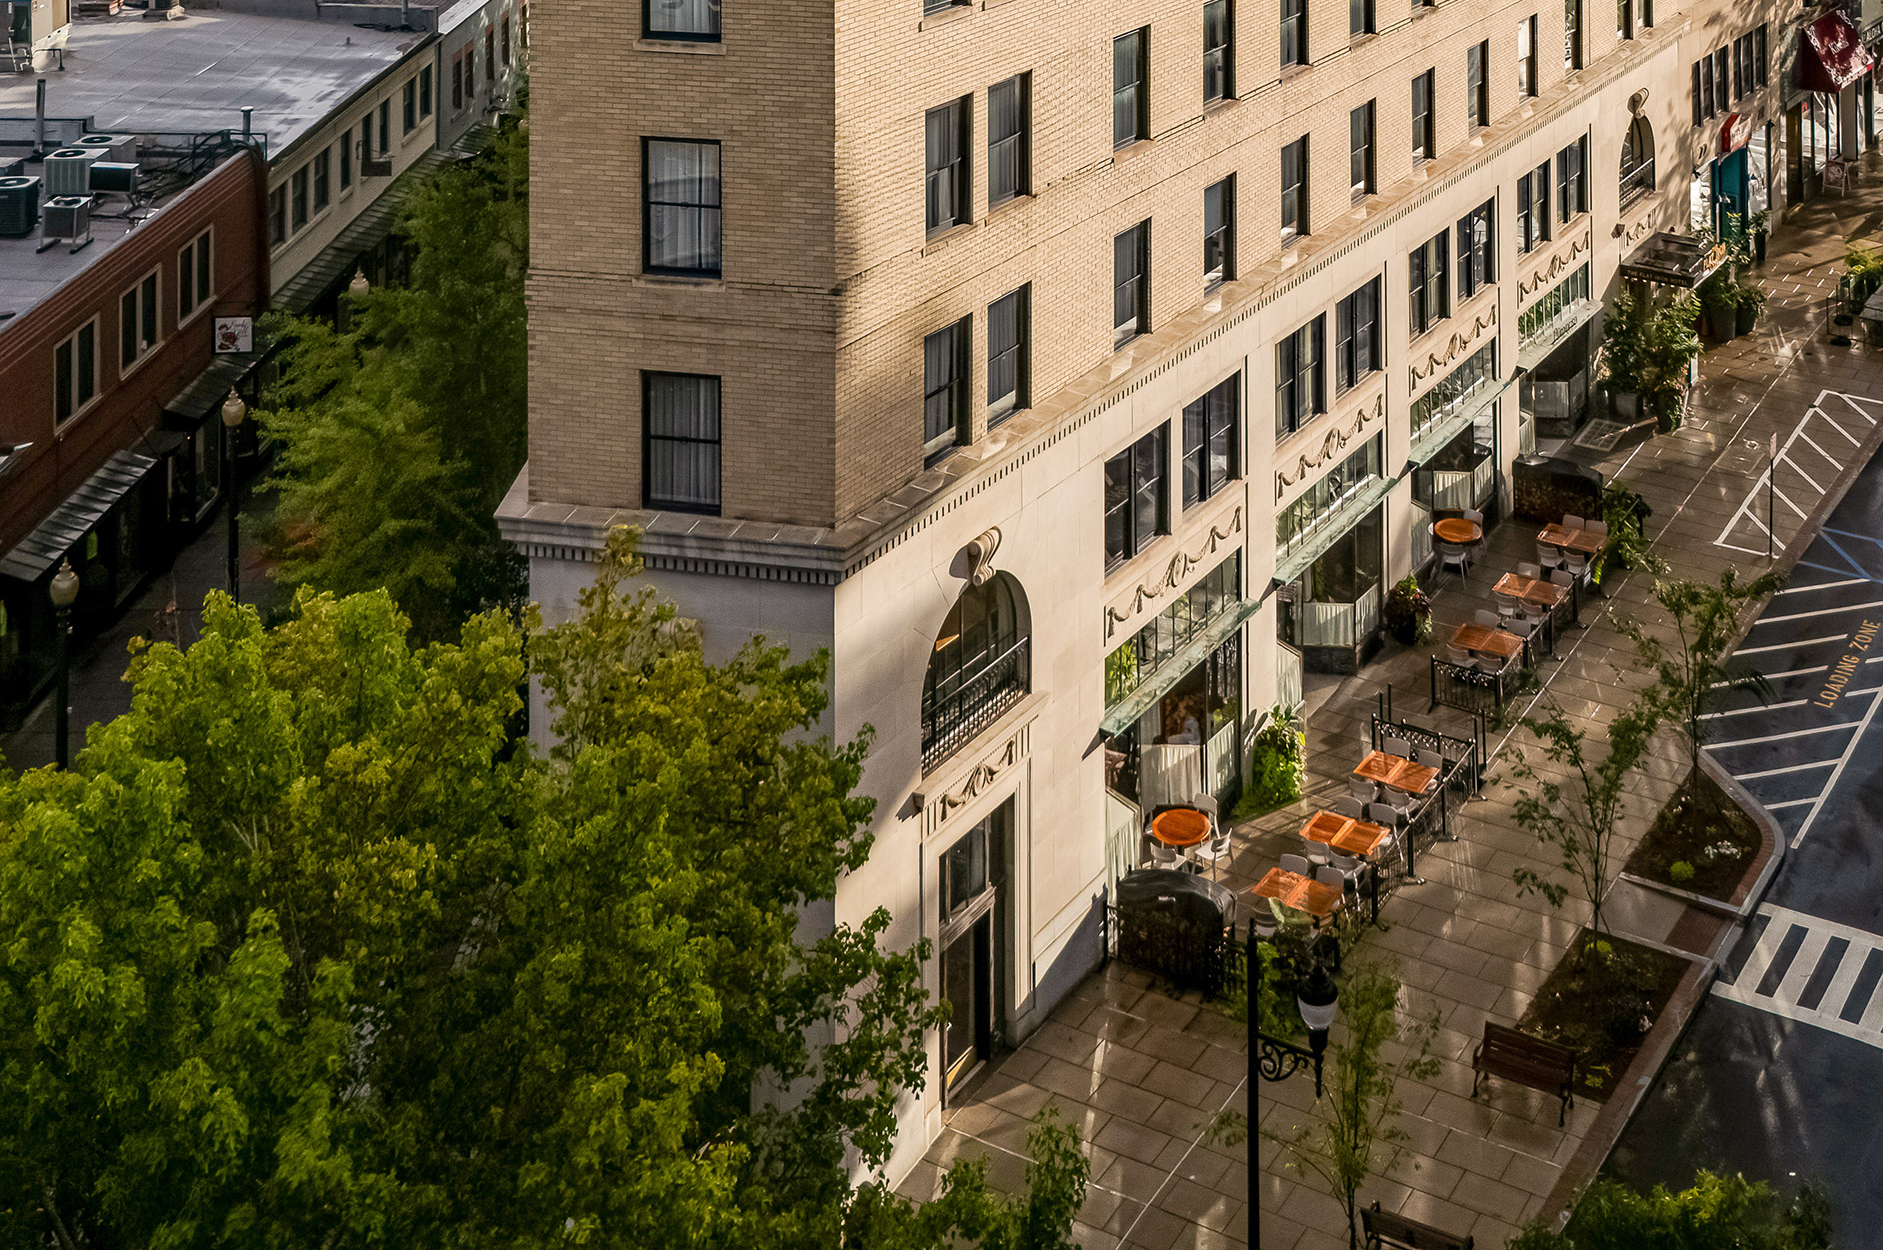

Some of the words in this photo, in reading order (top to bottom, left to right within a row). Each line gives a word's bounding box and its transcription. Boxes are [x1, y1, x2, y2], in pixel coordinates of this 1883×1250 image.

[1628, 269, 1639, 277] THE
[1640, 271, 1653, 280] FLAT
[1655, 274, 1668, 282] IRON
[1670, 277, 1688, 286] HOTEL
[1813, 654, 1860, 709] LOADING
[1849, 619, 1881, 652] ZONE
